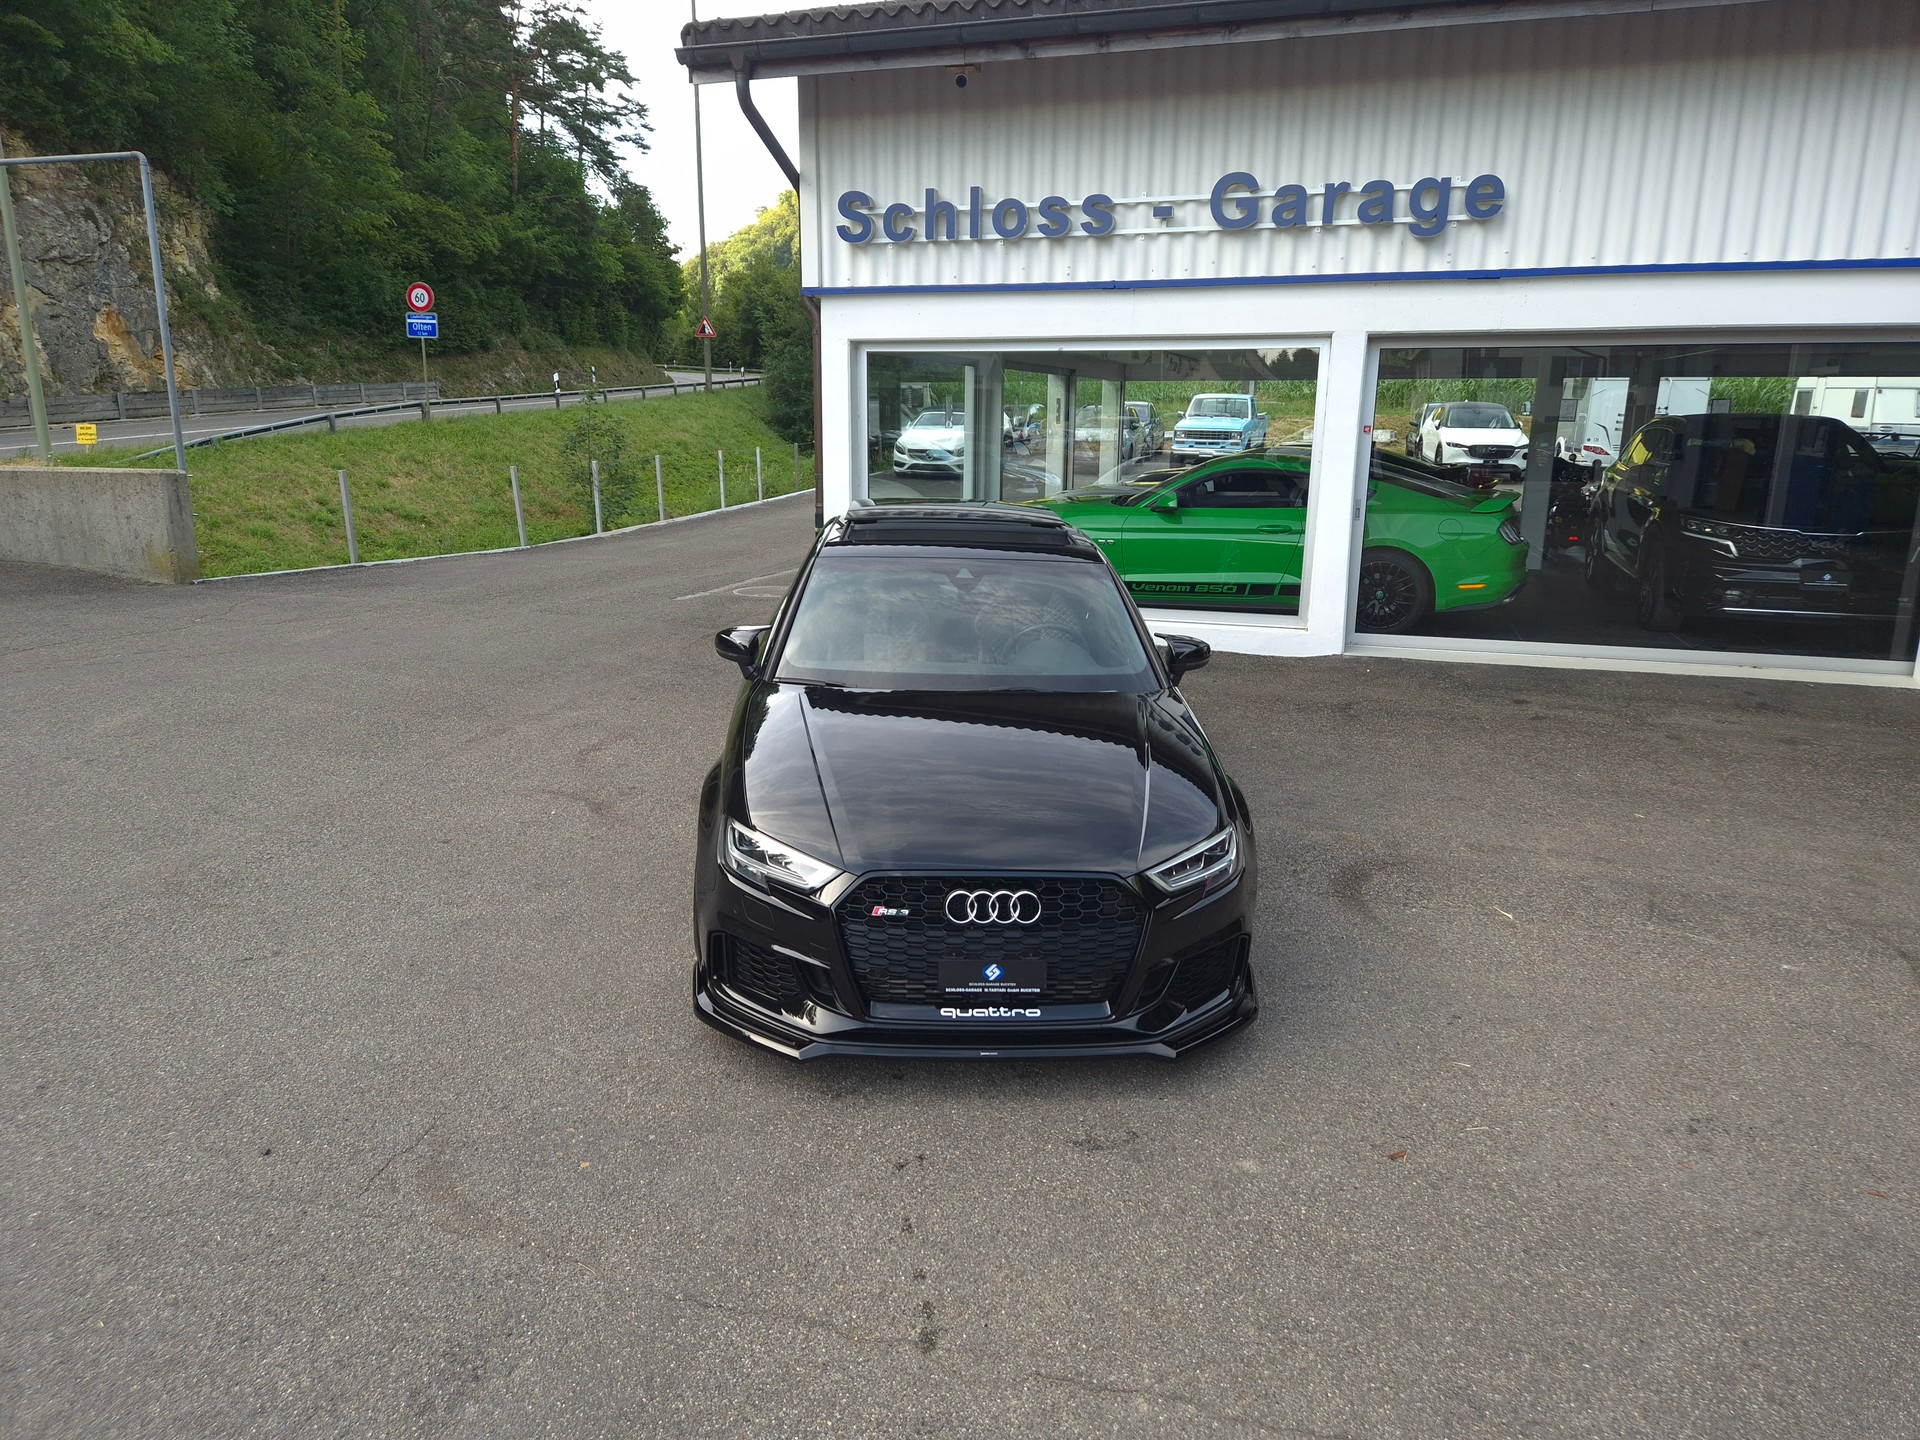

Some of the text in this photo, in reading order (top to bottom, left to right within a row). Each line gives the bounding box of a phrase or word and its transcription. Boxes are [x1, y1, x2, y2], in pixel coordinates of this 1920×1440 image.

[836, 186, 1115, 245] Schloss
[1210, 171, 1506, 239] Garage
[414, 292, 425, 303] 60
[412, 323, 432, 331] Olten
[1131, 582, 1238, 594] Venom 850
[940, 1006, 1041, 1019] quattro
